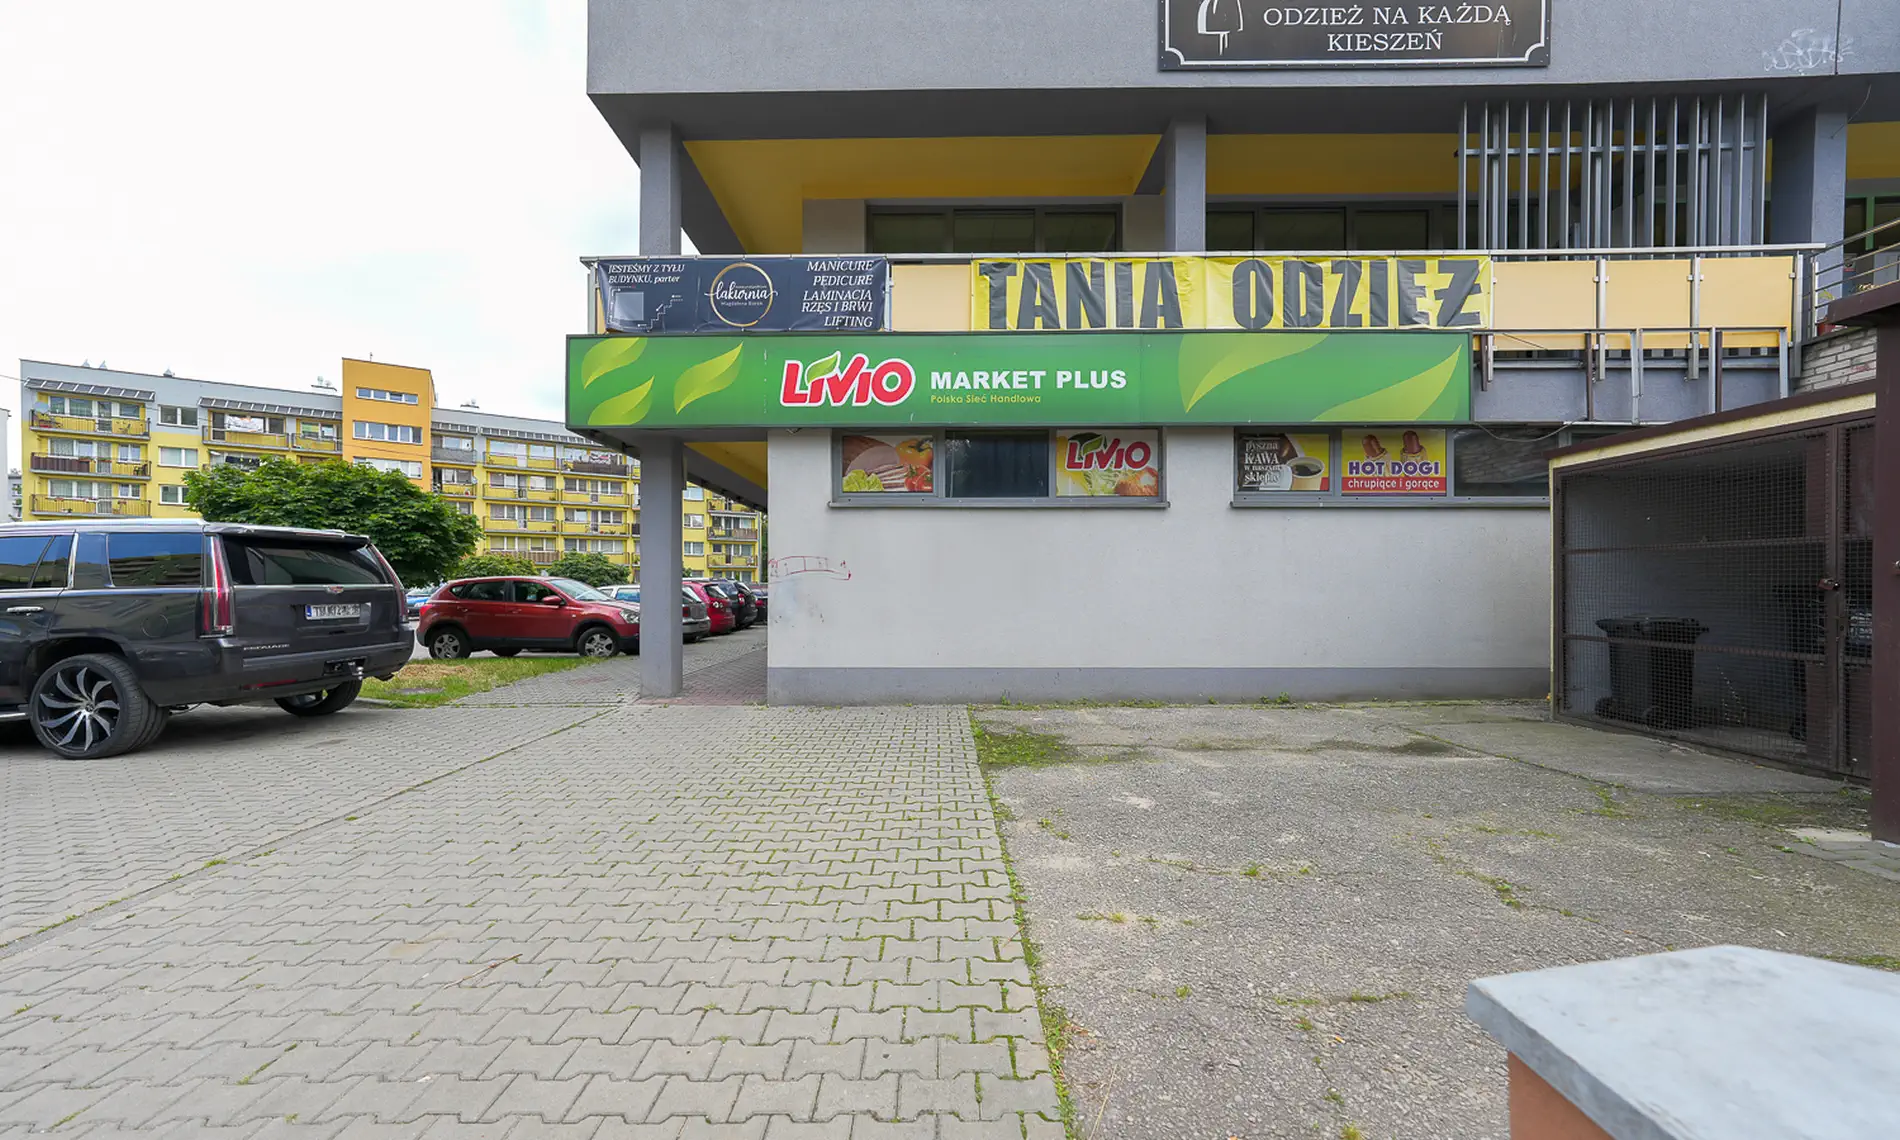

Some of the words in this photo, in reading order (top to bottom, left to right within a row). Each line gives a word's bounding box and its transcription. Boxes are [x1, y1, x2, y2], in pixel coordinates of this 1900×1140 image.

[1263, 4, 1365, 26] ODZIEŻ
[1372, 7, 1409, 25] NA
[1418, 2, 1512, 26] KAŻDĄ
[1327, 29, 1443, 52] KIESZEŃ
[607, 263, 653, 274] JESTEŚMY
[653, 264, 660, 273] Z
[661, 264, 685, 273] TYŁU
[806, 260, 874, 272] MANICURE
[653, 275, 680, 284] parter
[812, 274, 874, 286] PEDICURE
[803, 289, 873, 301] LAMINACJA
[978, 261, 1184, 330] TANIA
[801, 301, 832, 314] RZĘS
[834, 302, 839, 312] I
[841, 301, 873, 312] BRWI
[824, 316, 874, 328] LIFTING
[930, 370, 1047, 390] MARKET
[1056, 370, 1127, 389] PLUS
[930, 394, 964, 404] Polska
[965, 392, 987, 404] Sieć
[990, 394, 1041, 404] Handlowa
[1244, 452, 1279, 464] KAWA
[1348, 461, 1386, 476] HOT
[1390, 461, 1441, 476] DOGI
[1347, 479, 1397, 490] chrupiące
[1399, 479, 1403, 488] i
[1405, 480, 1440, 490] gorące
